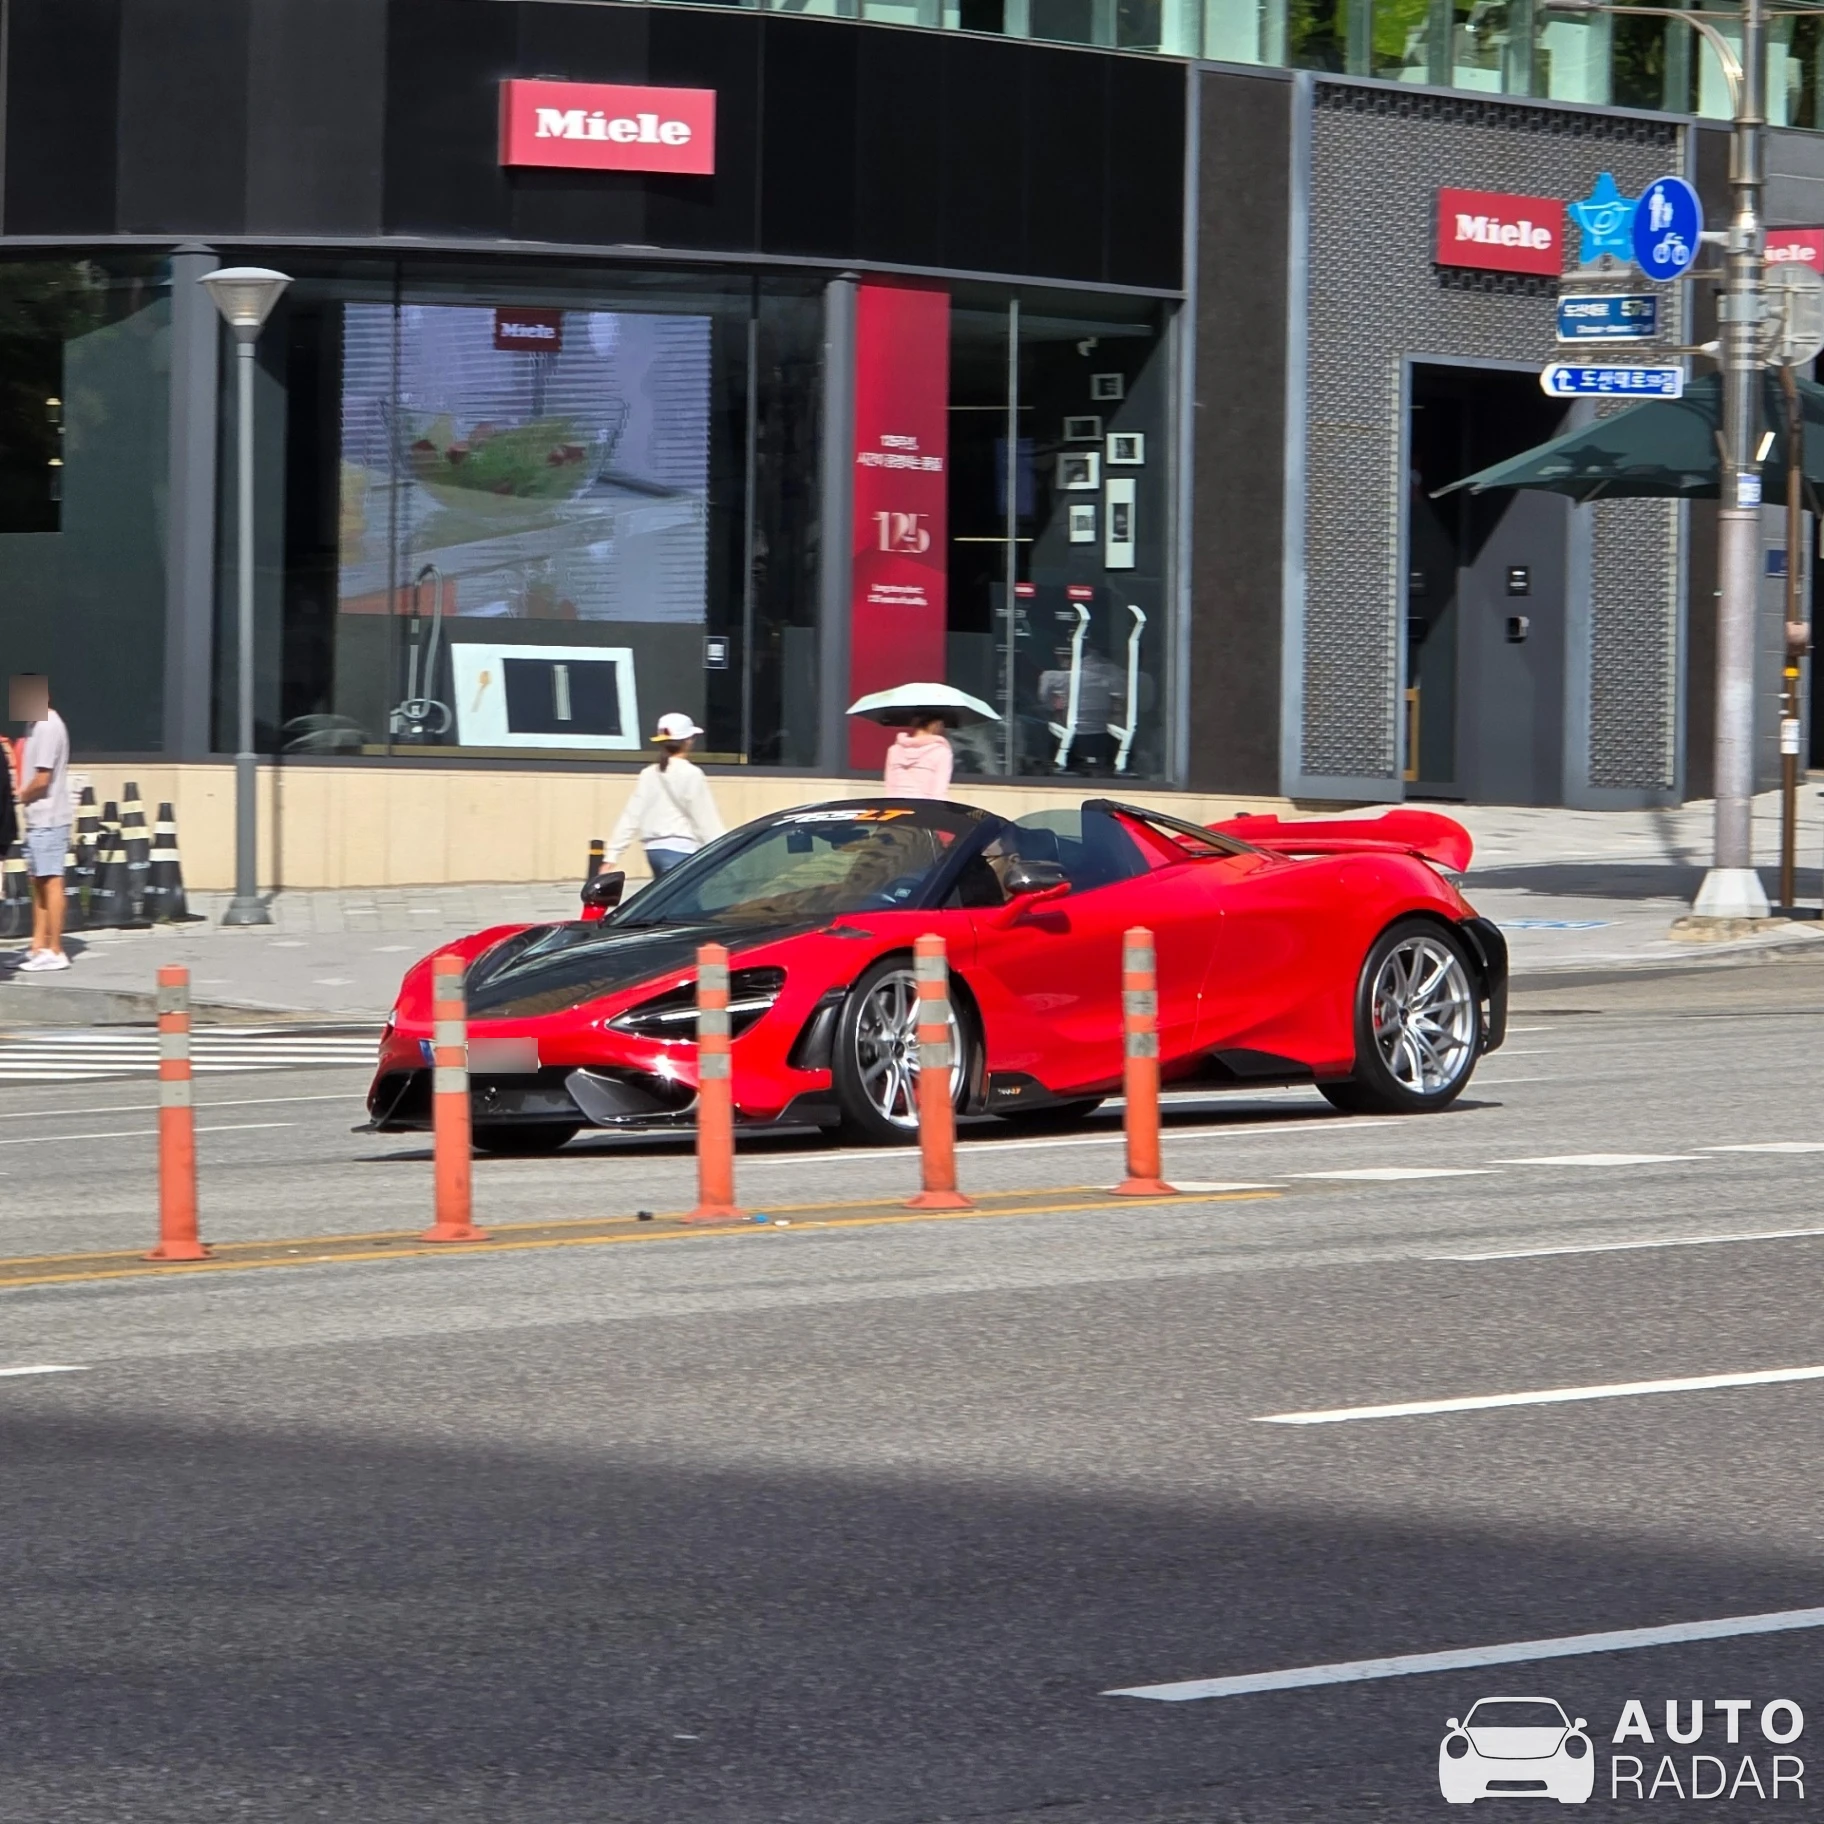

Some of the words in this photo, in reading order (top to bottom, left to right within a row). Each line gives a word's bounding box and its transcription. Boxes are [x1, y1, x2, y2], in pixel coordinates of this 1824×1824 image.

[535, 108, 692, 145] Miele
[1455, 213, 1552, 250] Miele
[1763, 244, 1817, 262] iele
[500, 322, 556, 339] Miele
[871, 511, 931, 554] 125
[771, 809, 916, 827] 765LT
